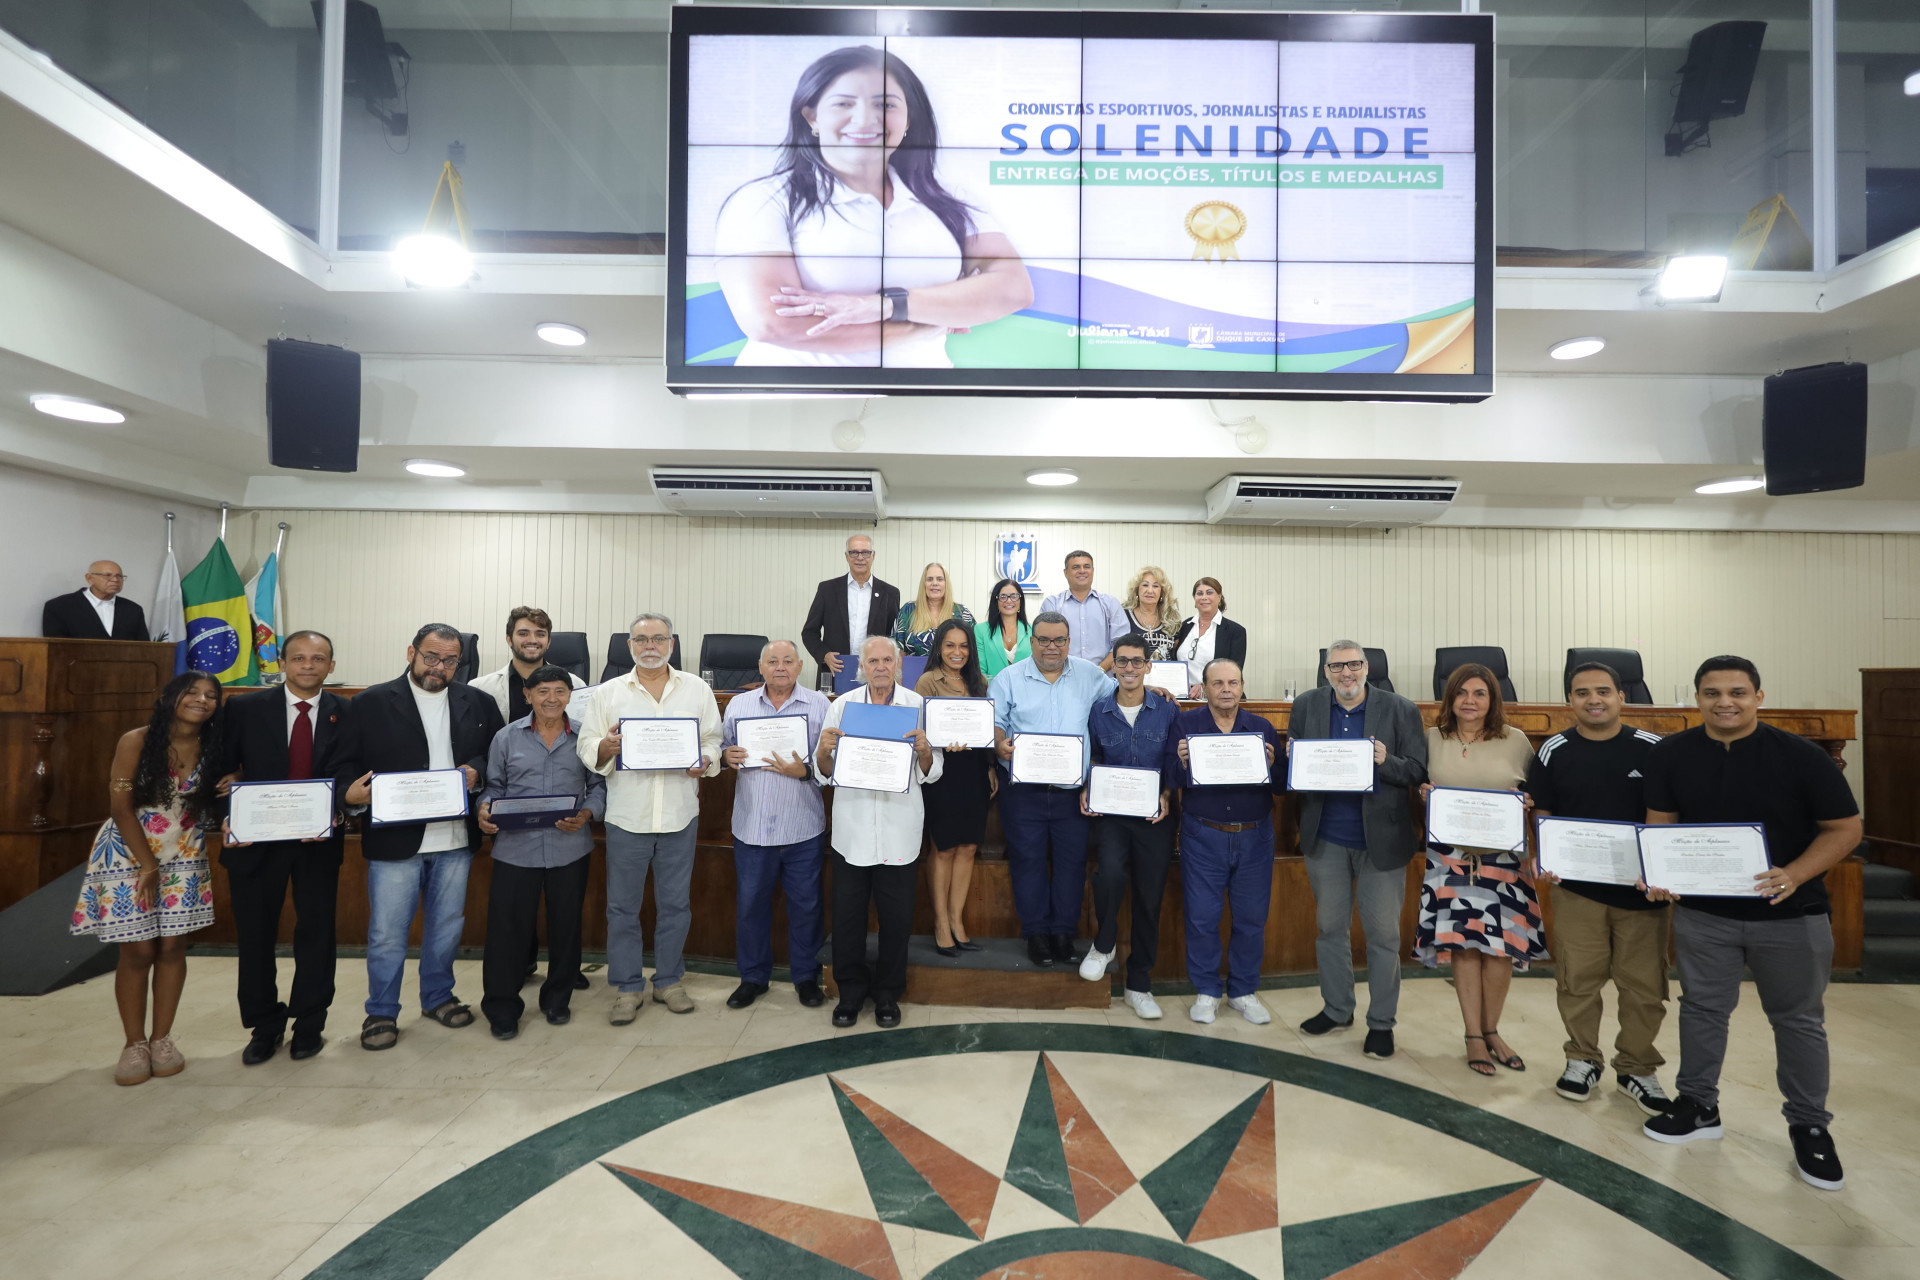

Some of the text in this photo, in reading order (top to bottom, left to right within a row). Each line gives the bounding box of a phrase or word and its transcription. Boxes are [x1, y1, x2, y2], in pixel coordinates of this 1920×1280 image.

[1008, 102, 1427, 119] CRONISTAS ESPORTIVOS, JORNALISTAS E RADIALISTAS
[1000, 123, 1429, 160] SOLENIDADE
[996, 165, 1438, 184] ENTREGA DE MOÇÕES, TÍTULOS E MEDALHAS
[1067, 325, 1128, 338] Juliana
[1216, 335, 1242, 343] DUQUE
